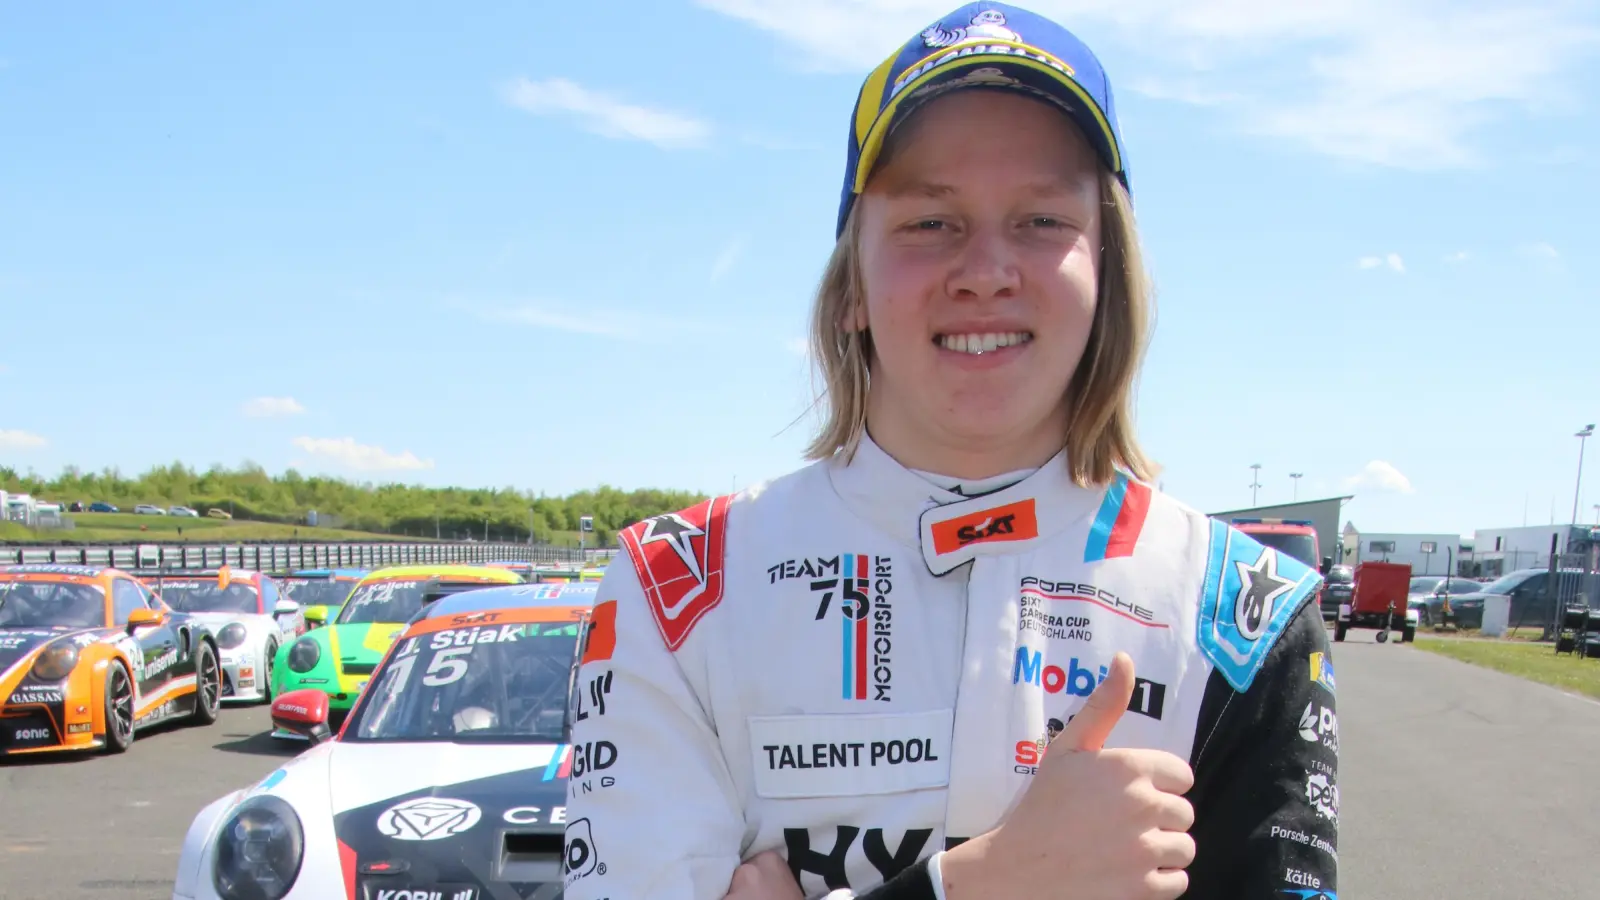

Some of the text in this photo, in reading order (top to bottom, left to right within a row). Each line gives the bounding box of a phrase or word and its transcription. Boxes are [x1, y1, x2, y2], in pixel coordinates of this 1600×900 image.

[767, 555, 840, 585] TEAM
[368, 581, 417, 592] Kellett
[810, 578, 870, 621] 75
[1020, 576, 1154, 621] PORSCHE
[1020, 596, 1041, 607] SIXT
[874, 555, 892, 702] MOTORSPORT
[1019, 619, 1093, 642] DEUTSCHLAND
[1020, 608, 1090, 628] CARRERA CUP
[397, 625, 518, 659] J. Stiak
[1013, 645, 1152, 713] Mobi 1
[11, 692, 63, 703] GASSAN
[570, 740, 618, 781] GID
[763, 738, 938, 770] TALENT POOL
[1311, 760, 1332, 776] TEAM
[1270, 825, 1310, 845] Porsche
[1284, 867, 1321, 889] Kälte
